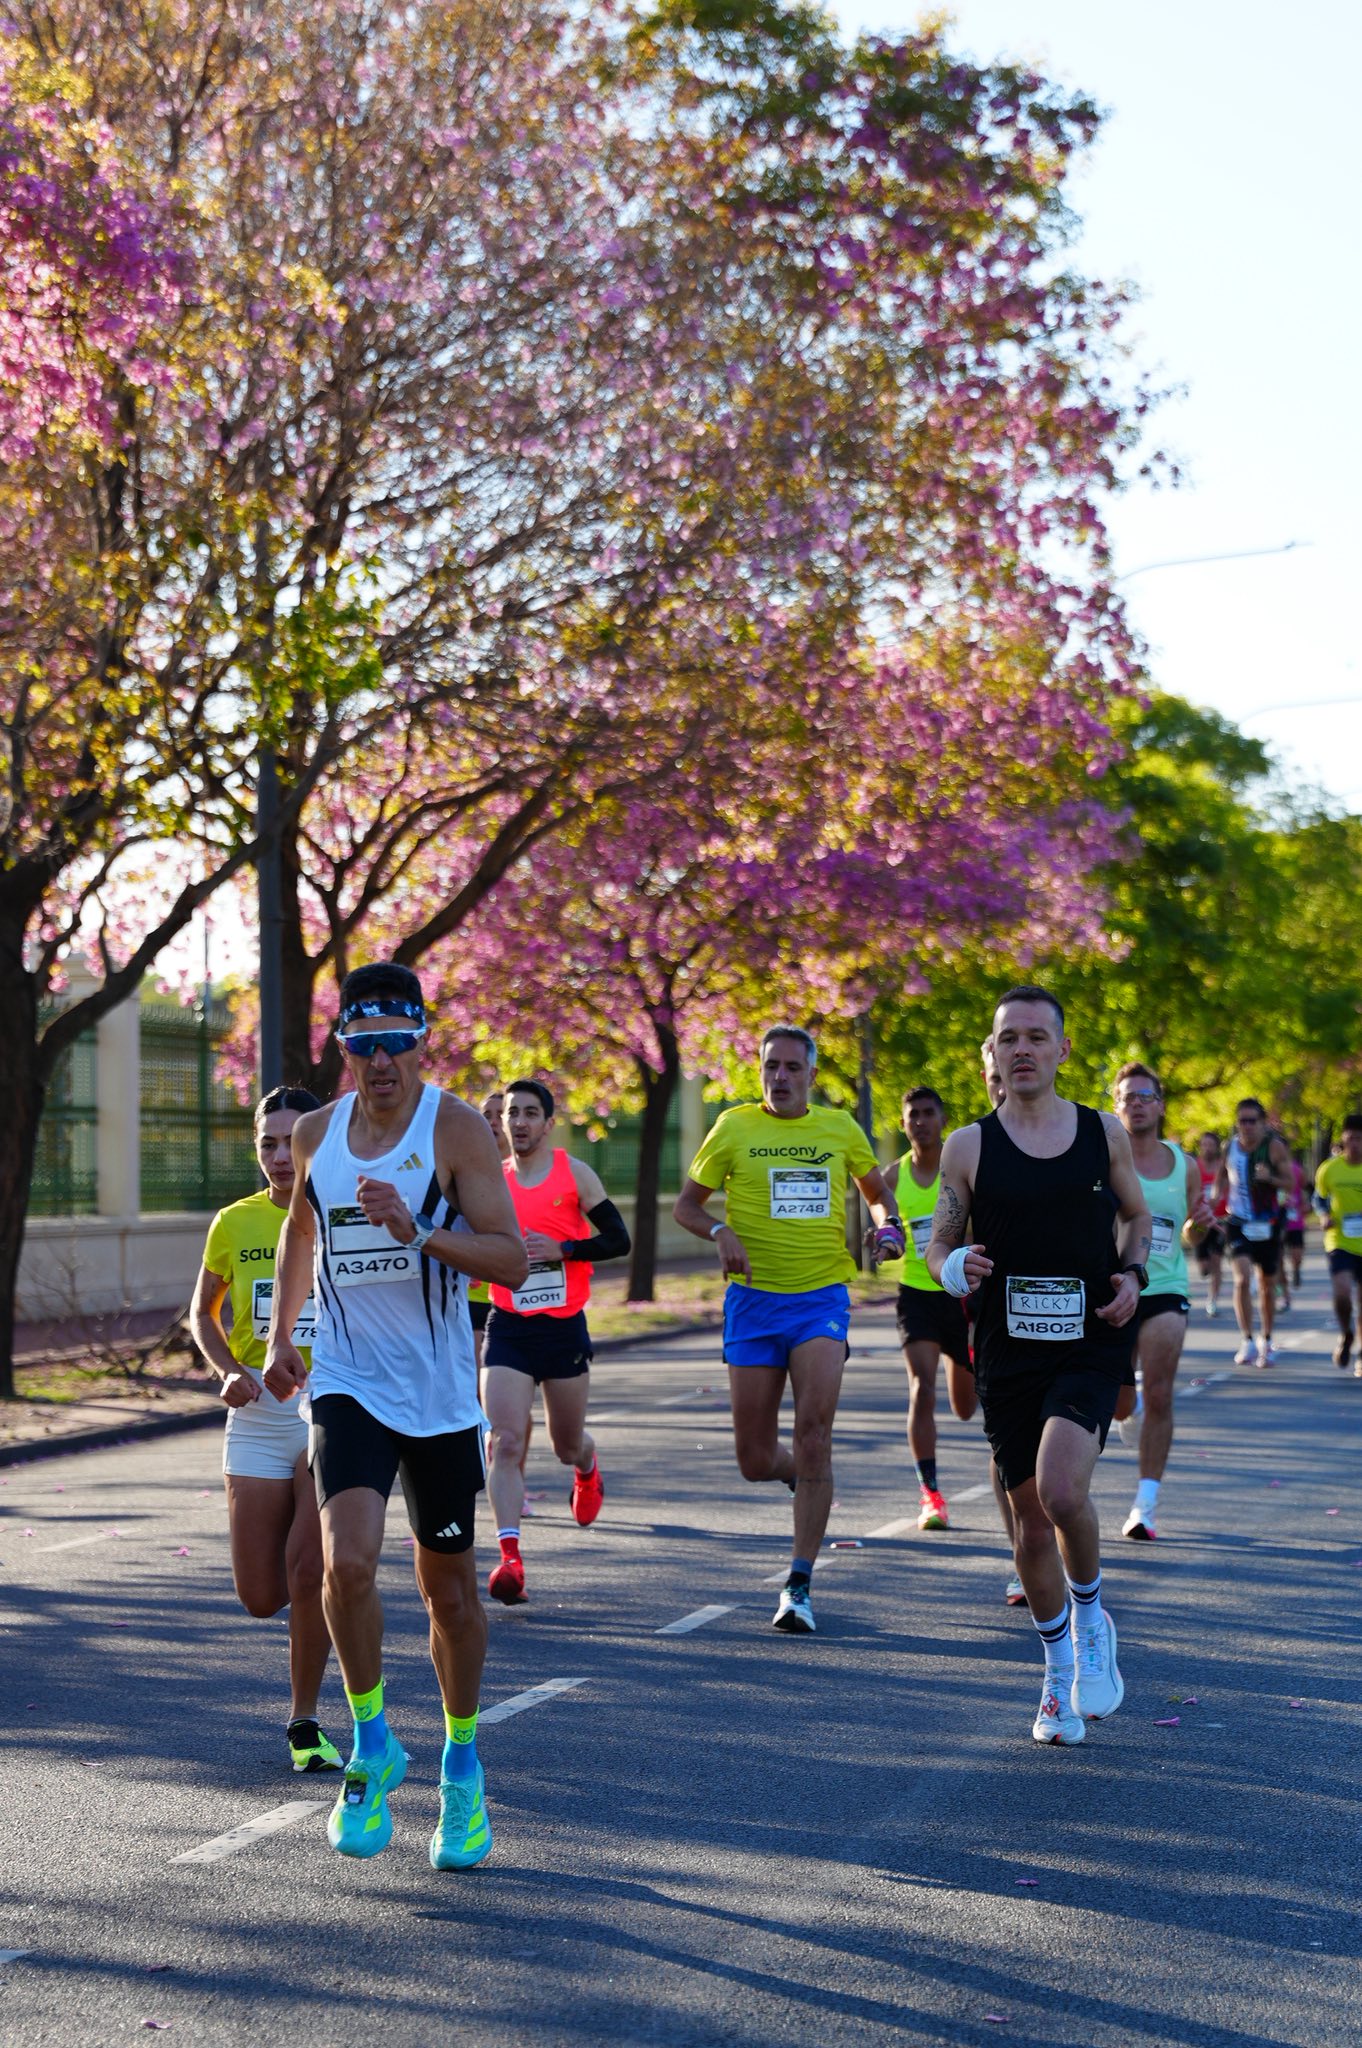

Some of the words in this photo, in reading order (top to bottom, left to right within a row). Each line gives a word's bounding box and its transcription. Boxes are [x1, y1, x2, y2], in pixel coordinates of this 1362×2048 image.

[749, 1146, 817, 1158] saucony
[777, 1204, 825, 1214] A2748
[336, 1257, 409, 1276] A3470
[520, 1293, 560, 1306] A0011
[259, 1325, 318, 1338] A778
[1015, 1321, 1076, 1334] A1802
